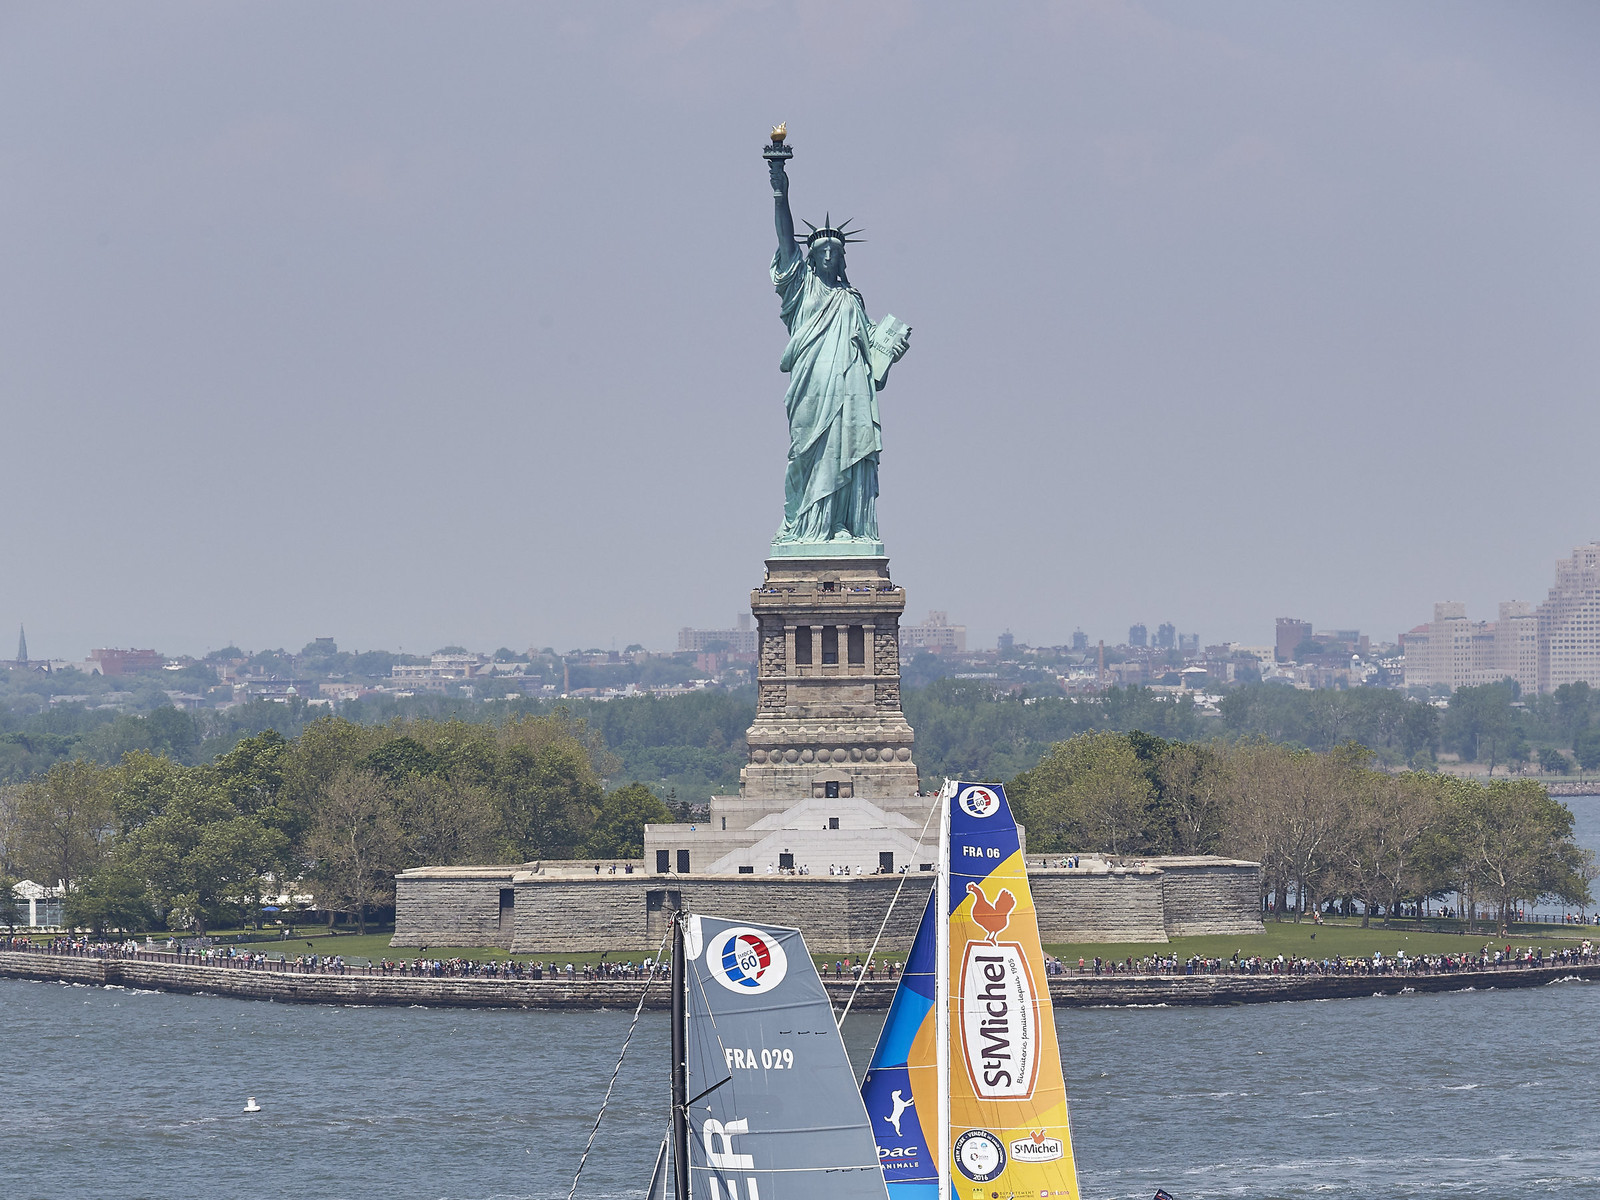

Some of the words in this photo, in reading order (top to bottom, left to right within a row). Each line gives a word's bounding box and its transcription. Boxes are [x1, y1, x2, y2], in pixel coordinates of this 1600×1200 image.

[975, 799, 985, 807] 60
[963, 846, 984, 858] FRA
[986, 847, 1001, 859] 06
[740, 955, 758, 971] 60
[1008, 958, 1018, 975] 1905
[1014, 975, 1026, 1004] depuis
[724, 1048, 758, 1070] FRA
[761, 1048, 794, 1070] 029
[876, 1145, 918, 1158] bac
